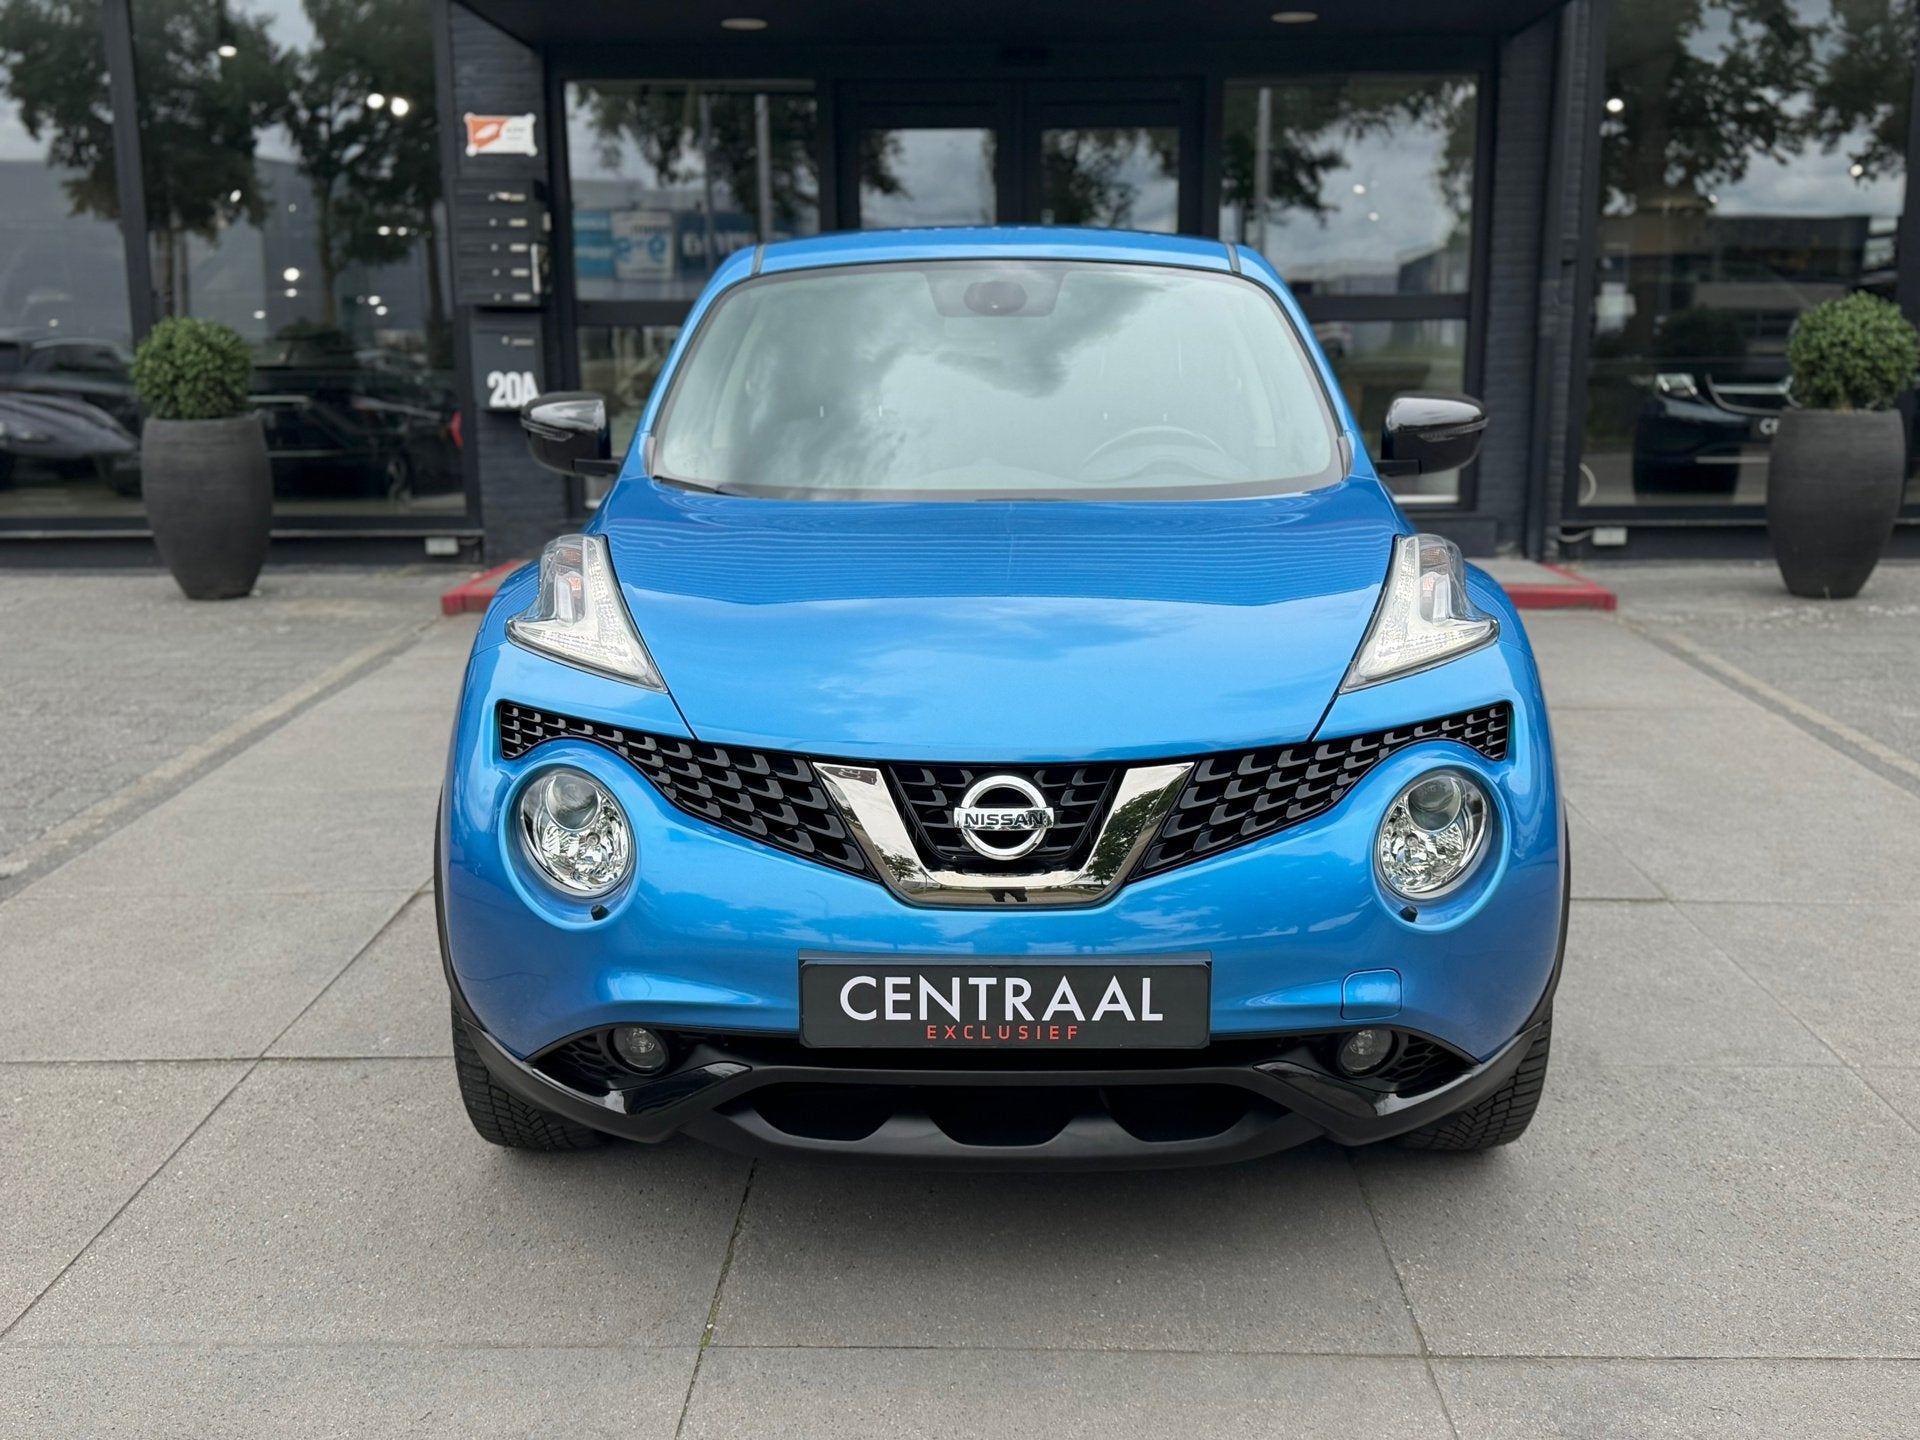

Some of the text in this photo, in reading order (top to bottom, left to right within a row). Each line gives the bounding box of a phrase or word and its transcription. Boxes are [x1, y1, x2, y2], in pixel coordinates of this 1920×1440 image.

[487, 370, 540, 408] 20A
[965, 813, 1043, 826] NISSAN
[839, 974, 1164, 1022] CENTRAAL
[927, 1025, 1079, 1040] EXCLUSIEF
